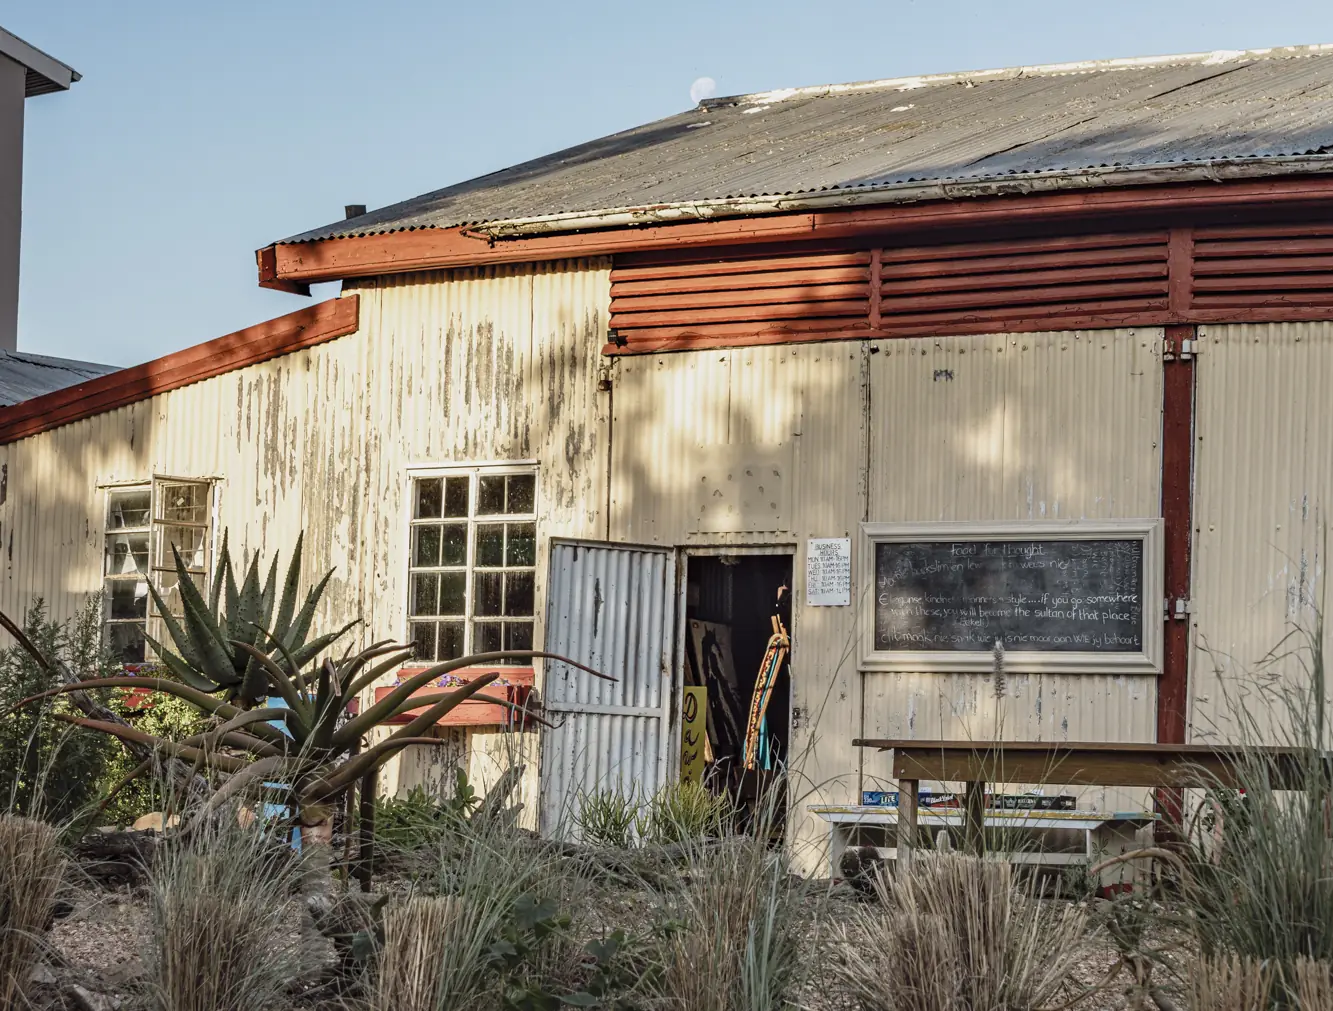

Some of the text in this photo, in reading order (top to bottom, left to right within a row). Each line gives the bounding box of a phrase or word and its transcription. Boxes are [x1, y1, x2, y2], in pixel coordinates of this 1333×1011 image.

[1052, 596, 1068, 608] you
[1071, 597, 1082, 609] go
[1086, 592, 1138, 604] somewhere
[1015, 607, 1030, 617] the
[1034, 606, 1065, 619] sultan
[1066, 607, 1077, 620] of
[1078, 608, 1099, 620] that
[1102, 608, 1130, 625] place
